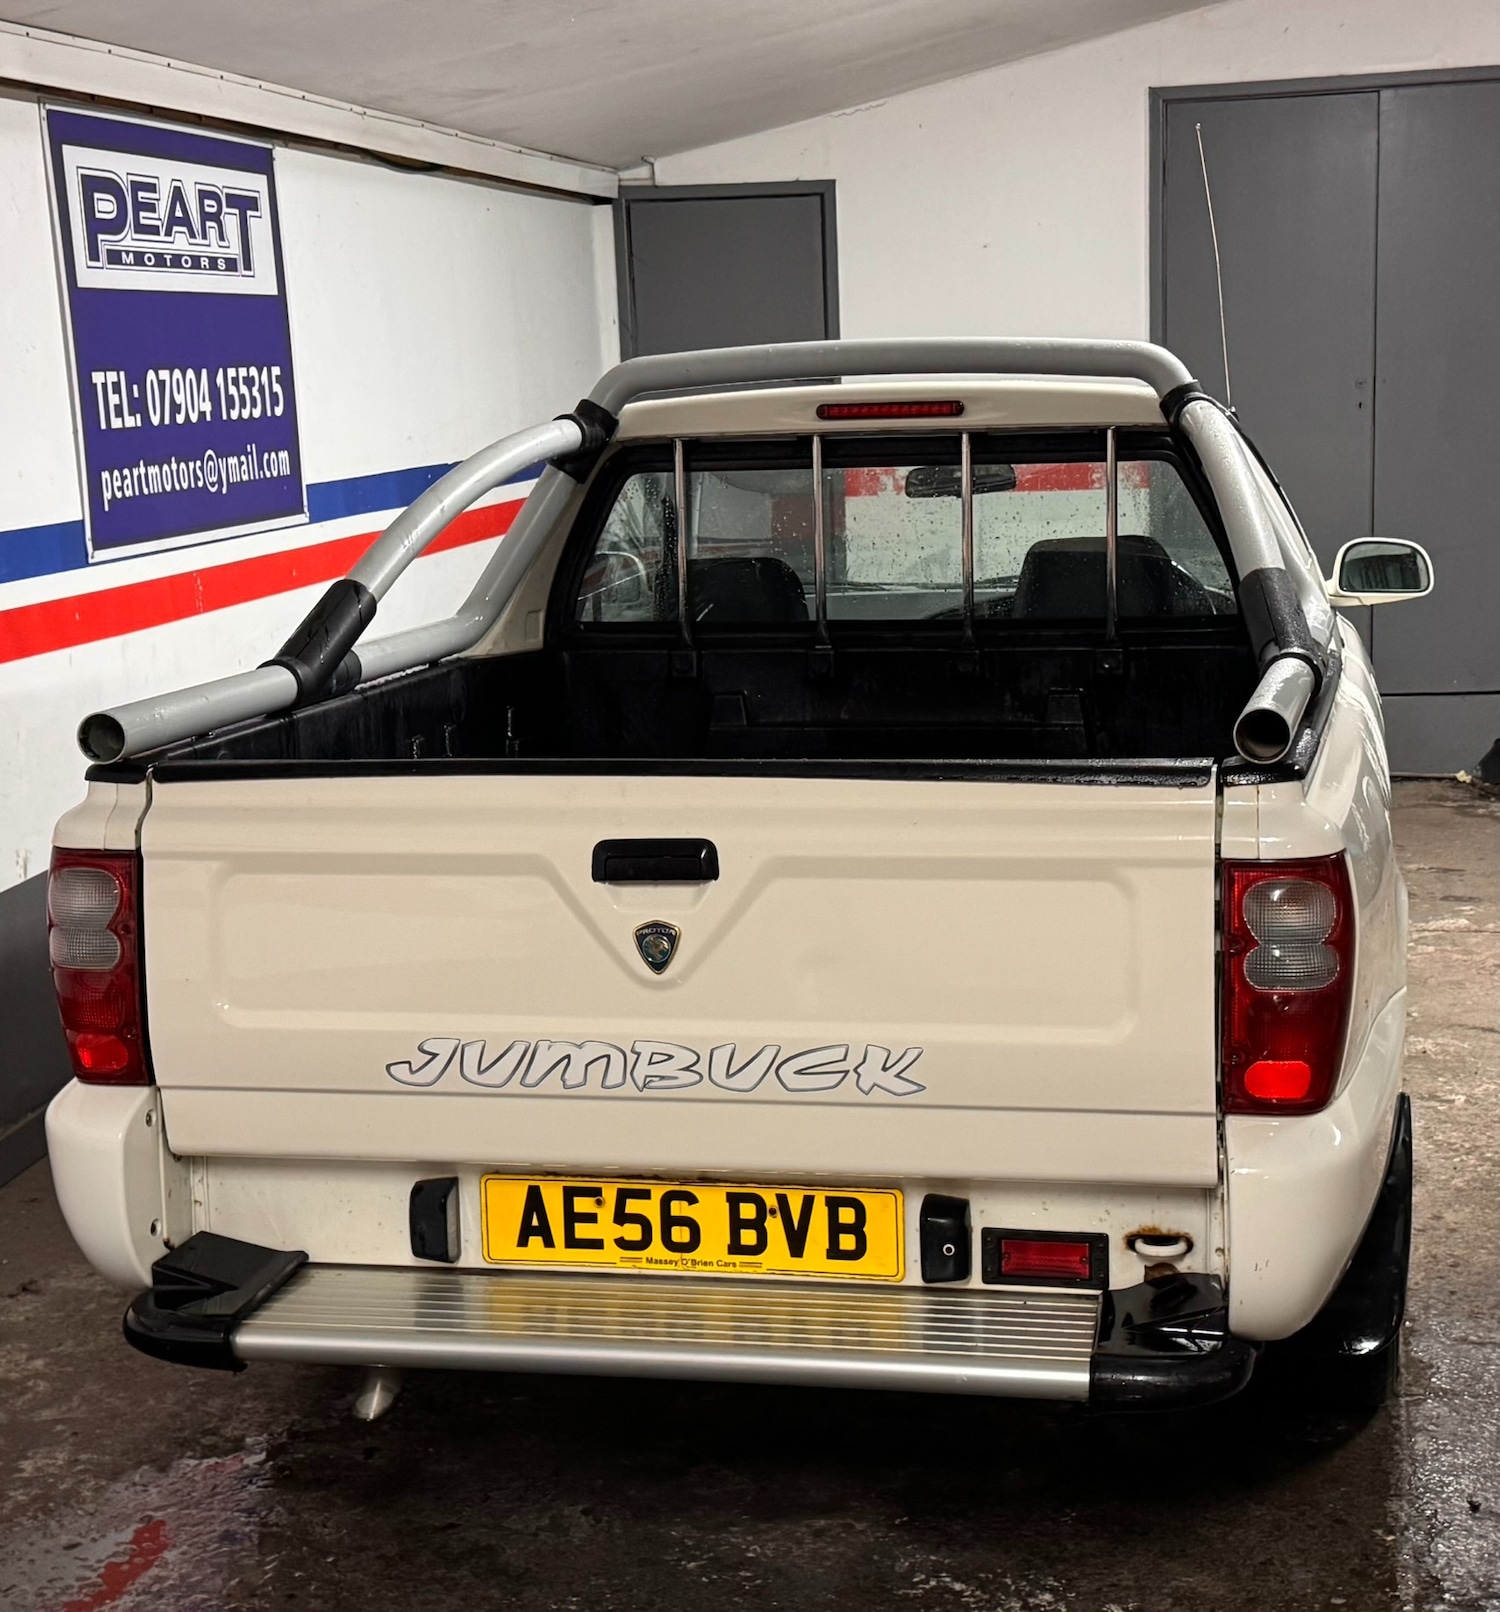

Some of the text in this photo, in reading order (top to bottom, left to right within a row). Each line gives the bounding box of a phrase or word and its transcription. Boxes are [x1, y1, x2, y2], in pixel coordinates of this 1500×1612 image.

[77, 166, 262, 278] PEART
[121, 251, 227, 271] MOTORS
[91, 366, 285, 430] TEL: 07904 155315
[101, 443, 291, 512] peartmotors@ymail.com
[386, 1037, 927, 1096] JUMBUCK
[515, 1184, 868, 1261] AE56 BVB
[645, 1256, 738, 1268] Massey O'Brien Cars
